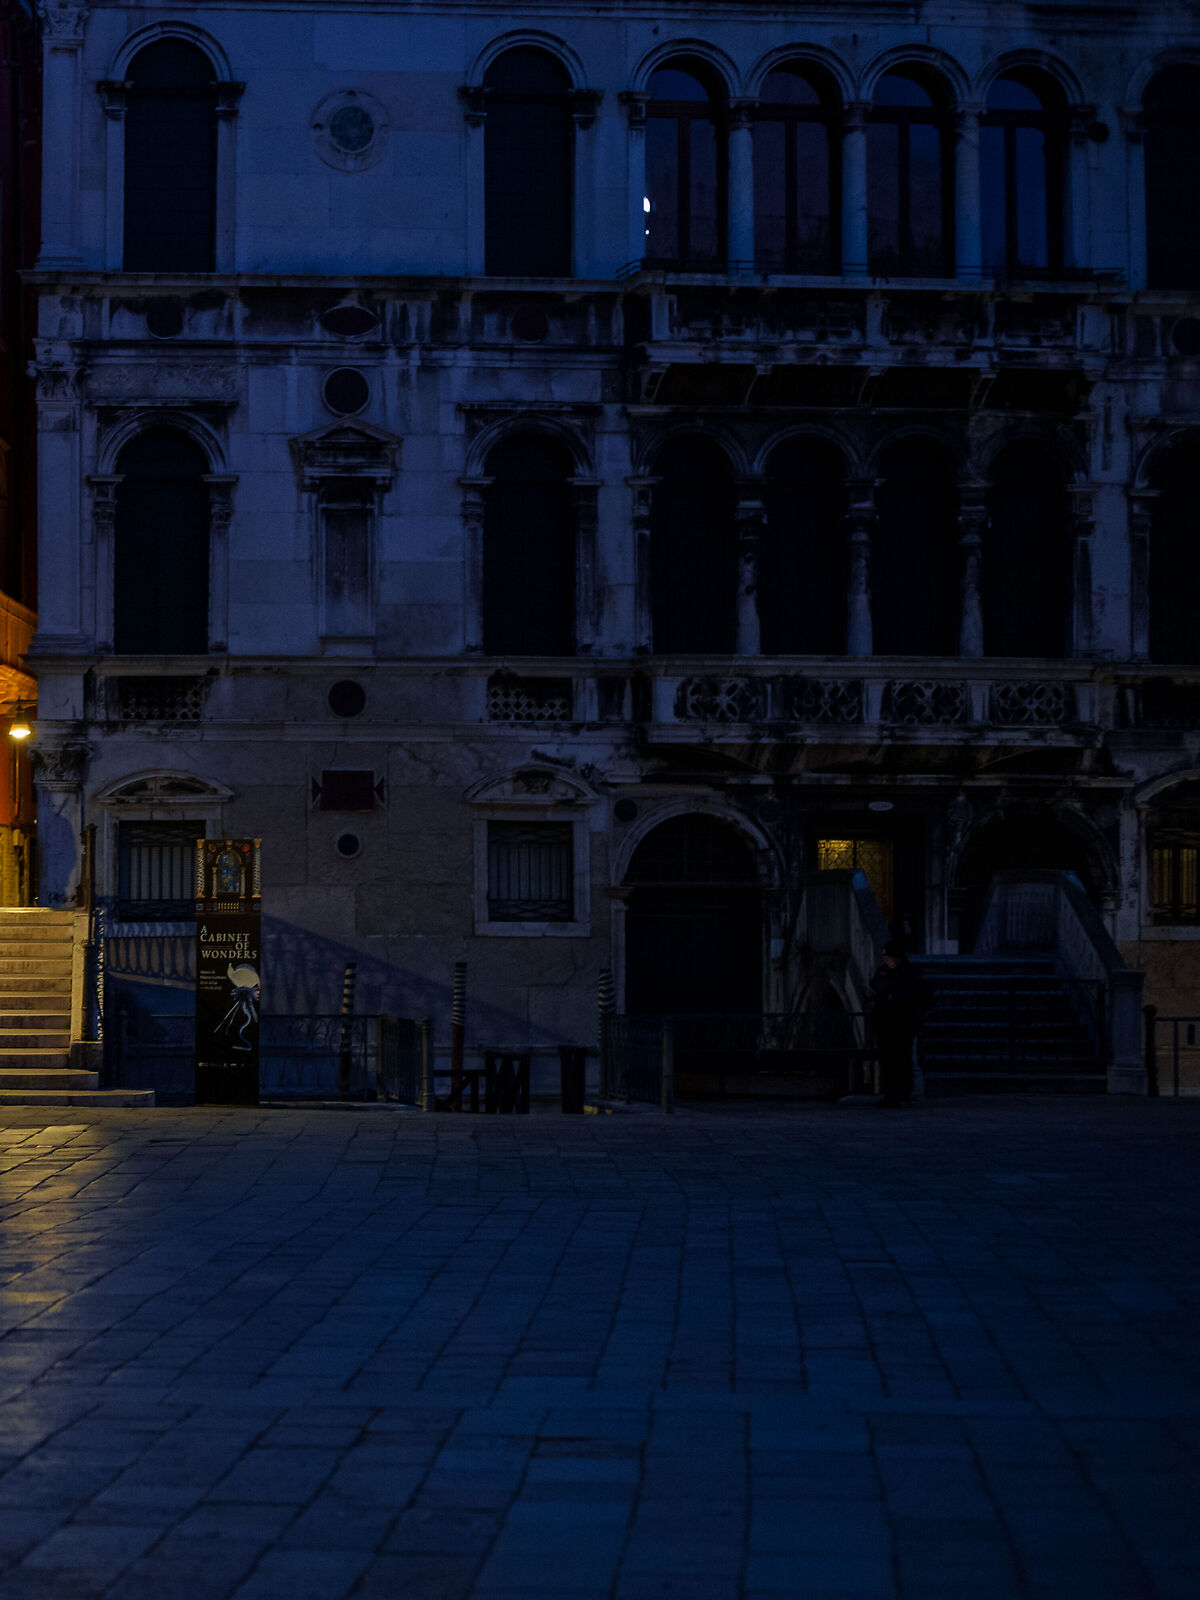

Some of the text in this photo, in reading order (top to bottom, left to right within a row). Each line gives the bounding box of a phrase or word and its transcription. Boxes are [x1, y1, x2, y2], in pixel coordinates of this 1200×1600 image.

[200, 925, 207, 933] A
[200, 933, 250, 942] CABINET
[235, 942, 250, 950] OF
[201, 950, 257, 959] WONDERS
